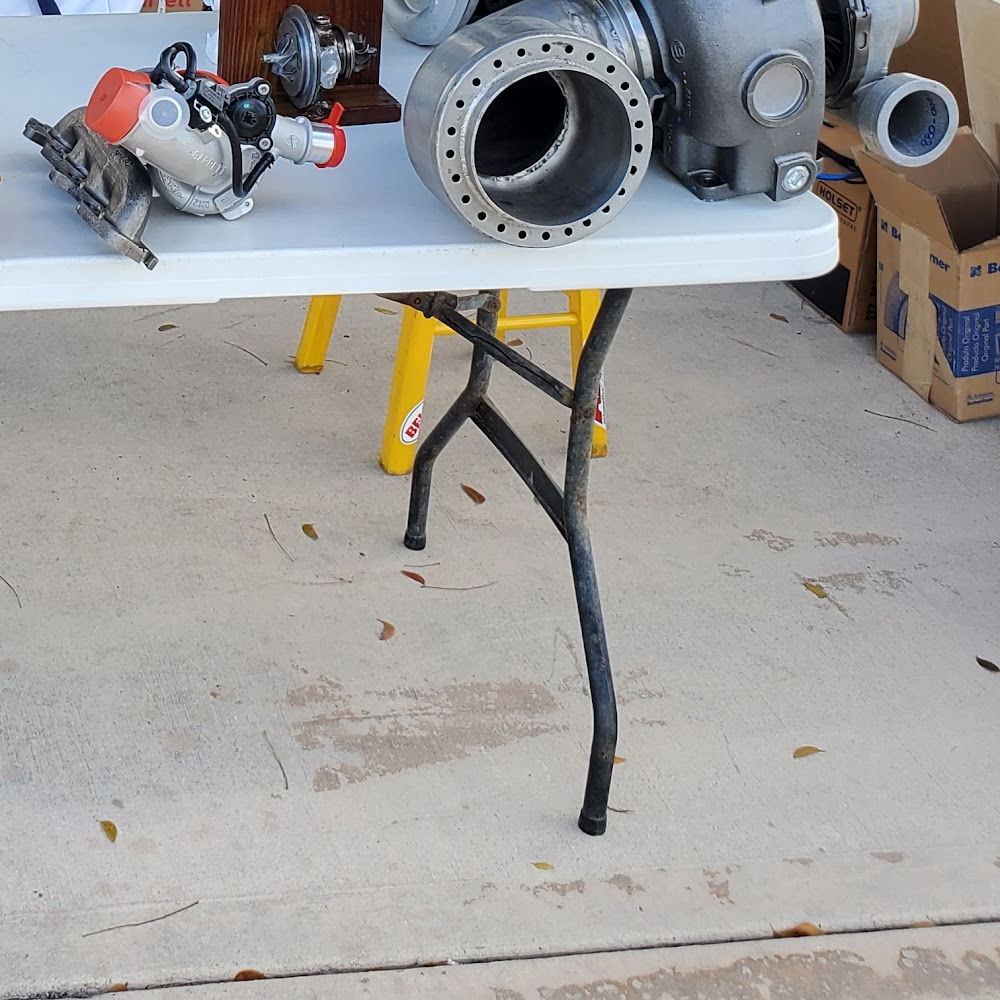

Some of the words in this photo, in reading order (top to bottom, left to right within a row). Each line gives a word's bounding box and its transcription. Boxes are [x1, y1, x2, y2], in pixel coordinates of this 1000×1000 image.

[819, 185, 856, 217] HOLSET
[961, 315, 971, 345] Original
[972, 311, 981, 341] Original
[982, 318, 990, 332] Part
[981, 333, 990, 362] Original
[405, 413, 422, 438] BE
